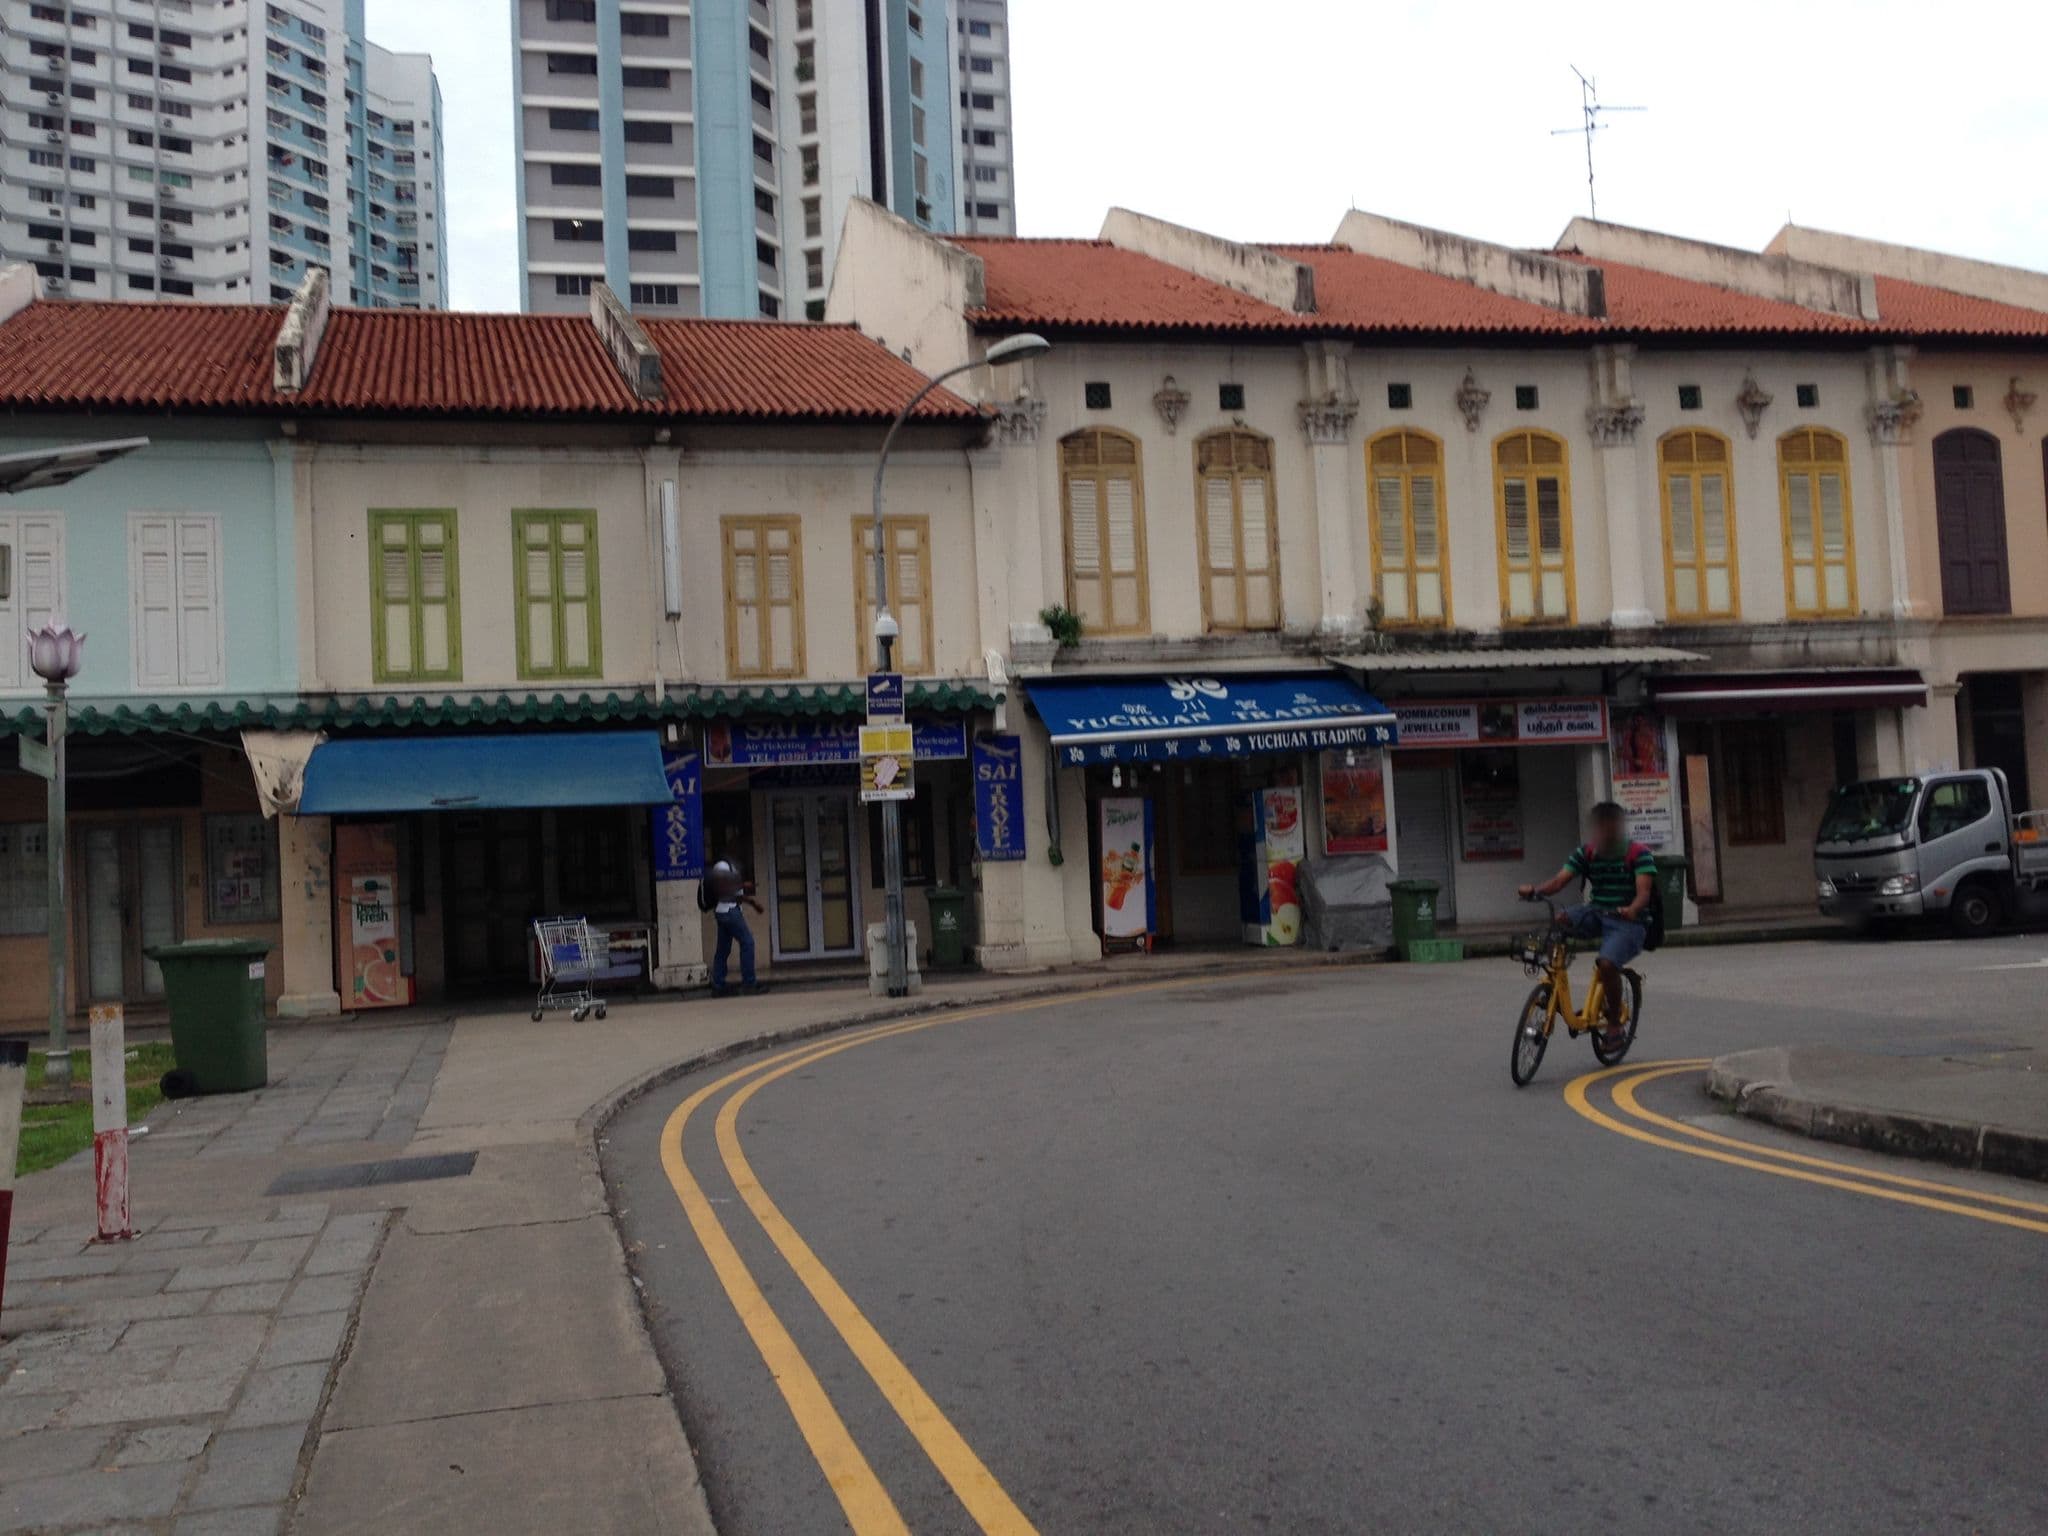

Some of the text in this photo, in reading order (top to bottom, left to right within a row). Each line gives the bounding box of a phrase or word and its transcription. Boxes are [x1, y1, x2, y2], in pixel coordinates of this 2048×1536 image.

[1067, 704, 1363, 729] YUCHUAN TRADING
[1402, 722, 1460, 734] JEWELLERS
[763, 742, 806, 752] Ticketing
[916, 736, 958, 746] Packages
[1248, 731, 1308, 751] YUCHUAN
[1311, 727, 1366, 746] TRADING
[978, 763, 1017, 781] SAI
[671, 777, 696, 794] AI
